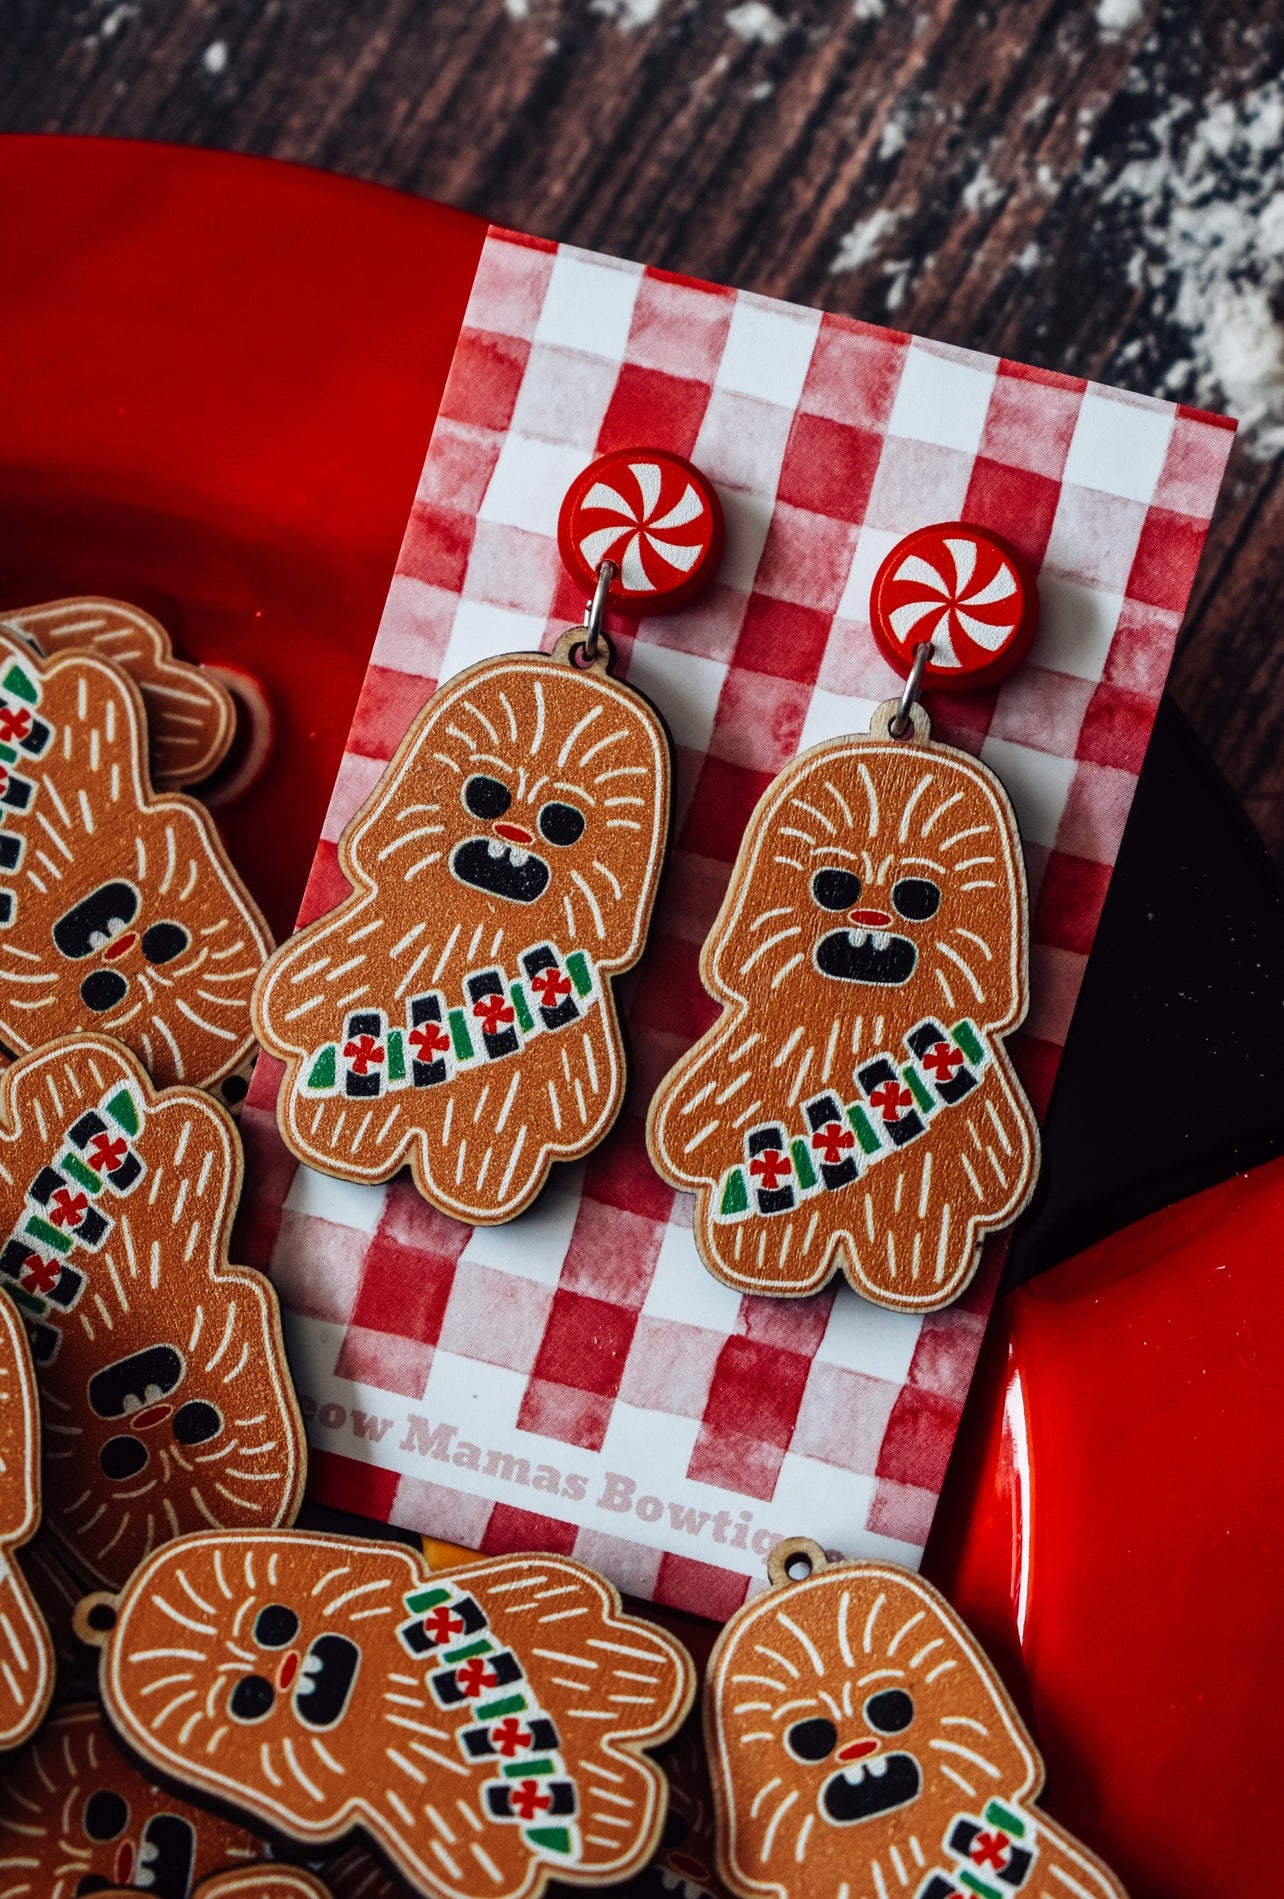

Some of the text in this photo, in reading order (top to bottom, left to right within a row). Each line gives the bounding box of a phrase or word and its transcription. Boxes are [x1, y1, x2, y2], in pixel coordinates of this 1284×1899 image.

[301, 1394, 845, 1565] eow Mamas Bowtiq
